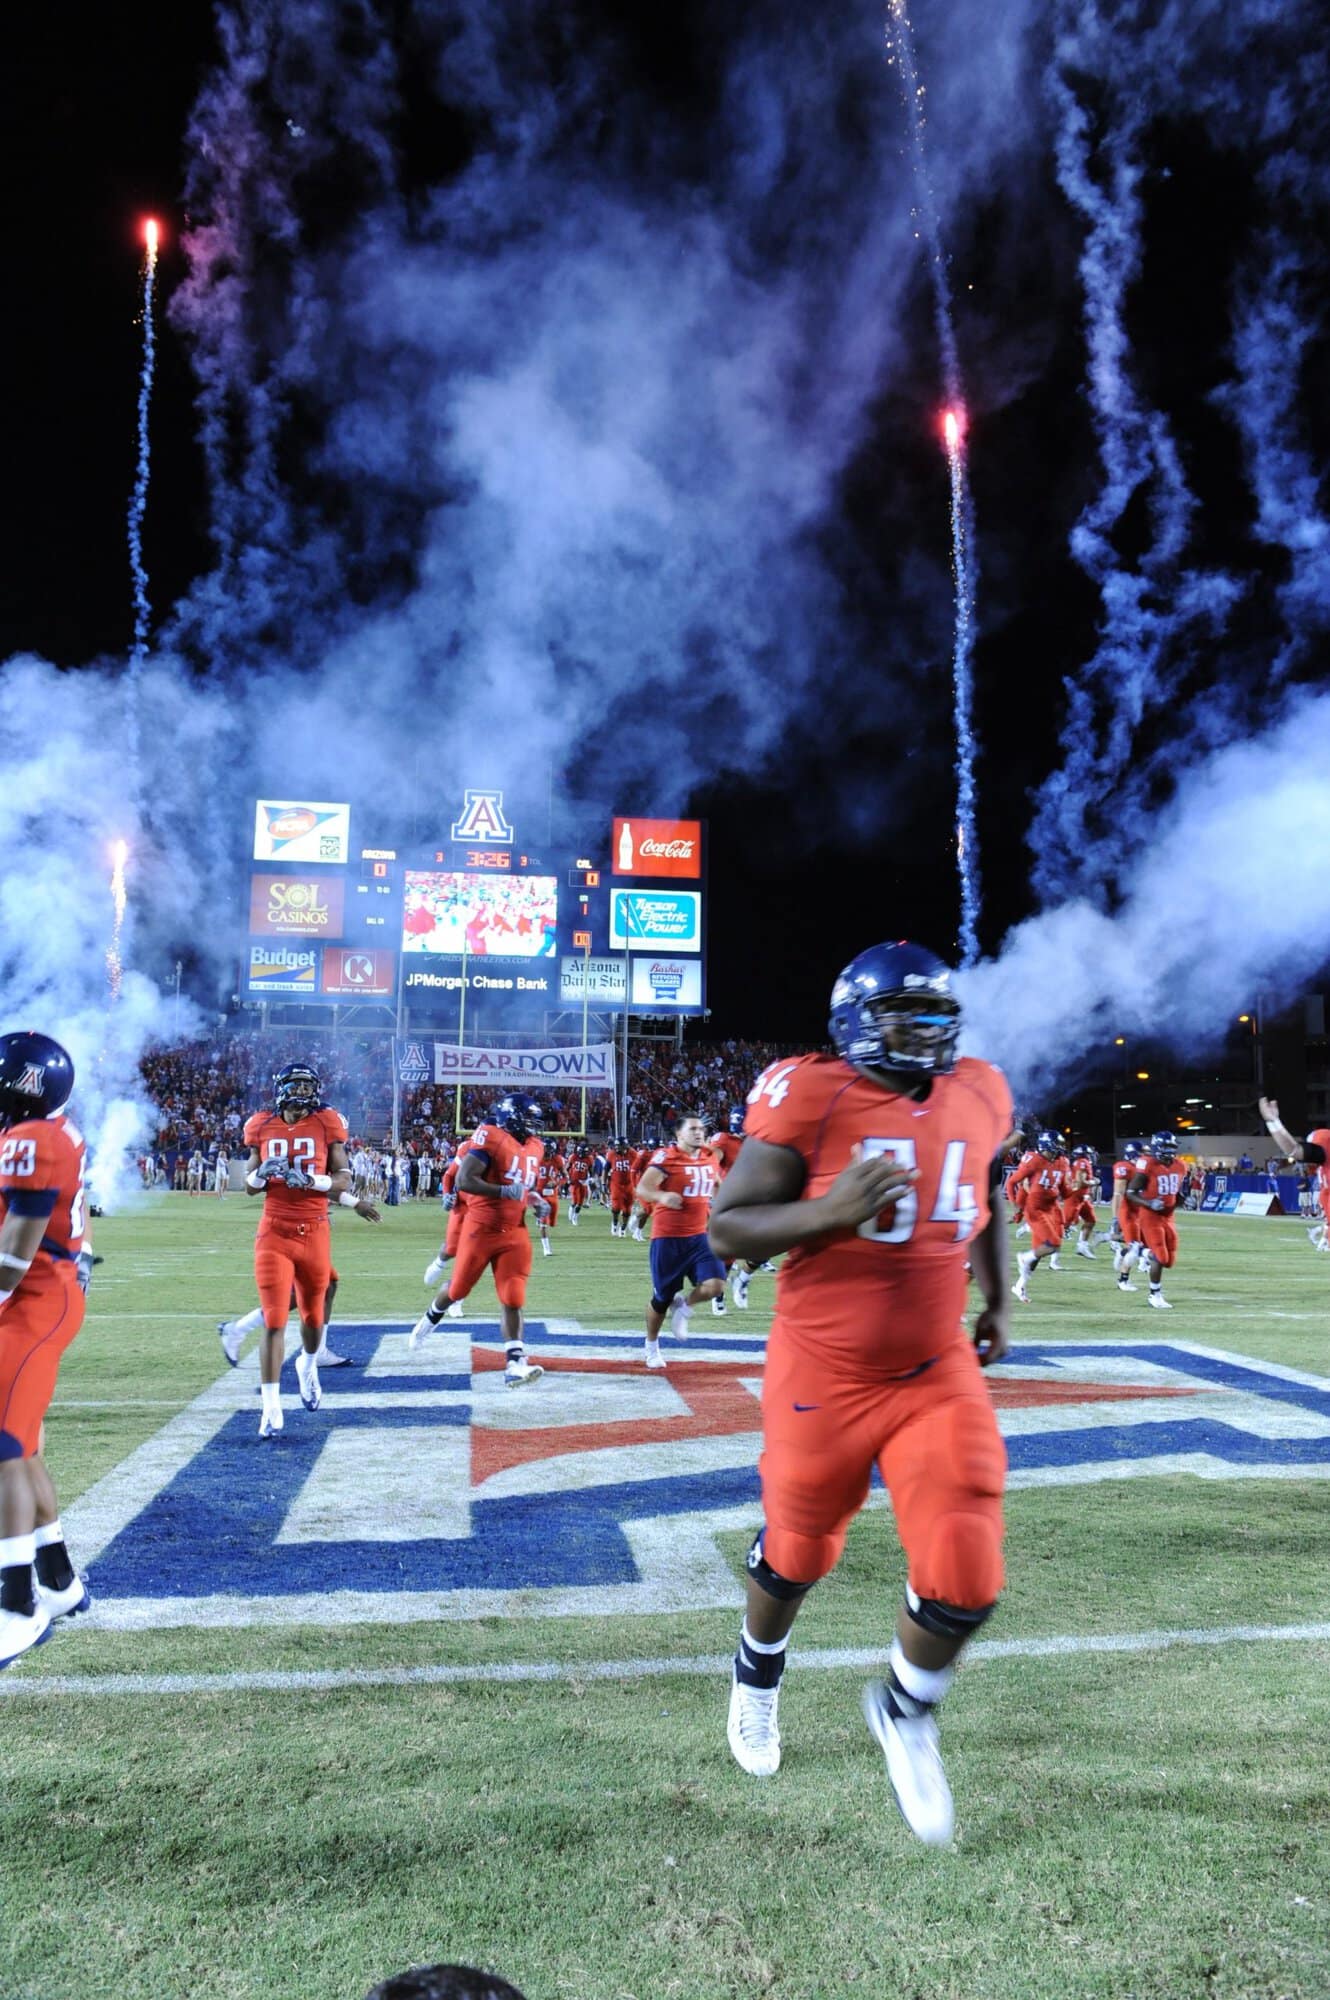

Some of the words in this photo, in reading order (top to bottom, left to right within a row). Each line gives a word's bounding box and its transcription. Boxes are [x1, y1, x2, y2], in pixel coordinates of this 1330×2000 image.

[452, 789, 513, 843] A
[268, 882, 328, 911] SOL
[635, 898, 677, 911] Tucson
[267, 910, 329, 924] CASINOS
[639, 910, 689, 923] Electric
[644, 921, 688, 934] Power
[251, 946, 316, 970] Budget
[569, 960, 620, 973] Arzona
[406, 973, 469, 990] JPMorgan
[472, 976, 513, 989] Chase
[516, 977, 548, 990] Bank
[518, 1052, 607, 1073] DOWN
[400, 1072, 429, 1081] CLUB
[0, 1139, 37, 1177] 23
[504, 1155, 538, 1191] 46
[682, 1165, 715, 1198] 36
[1038, 1169, 1062, 1190] 47
[1157, 1173, 1180, 1196] 88
